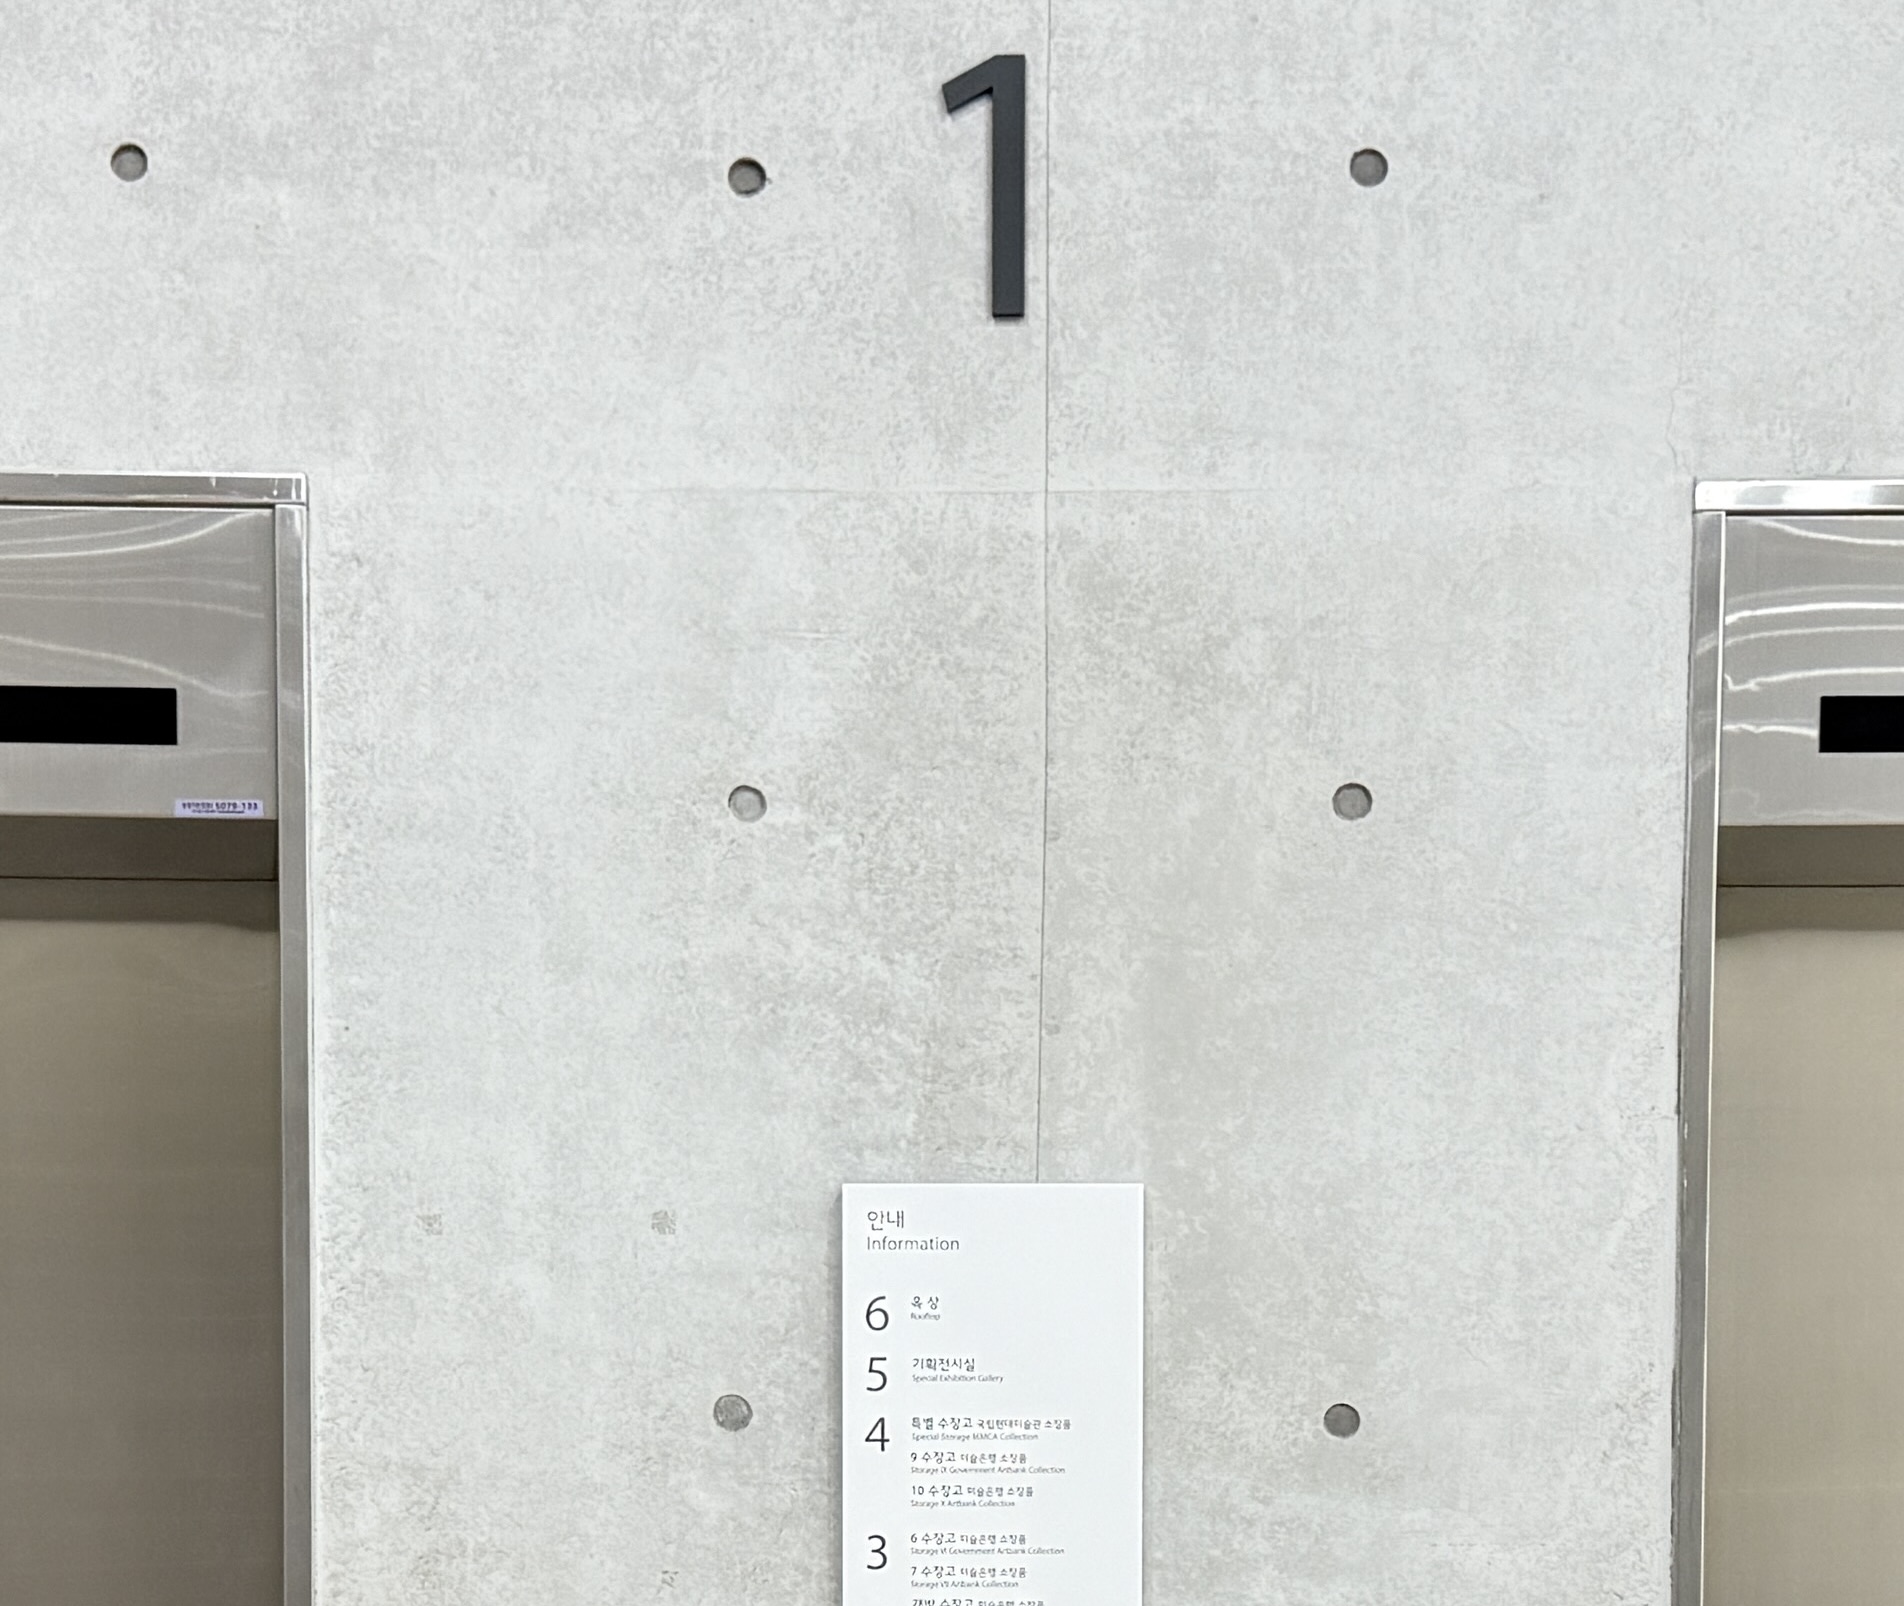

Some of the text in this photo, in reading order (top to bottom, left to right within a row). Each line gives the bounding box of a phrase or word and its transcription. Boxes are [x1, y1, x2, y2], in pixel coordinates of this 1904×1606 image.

[942, 55, 1026, 317] 1
[867, 1210, 905, 1231] 안내
[867, 1236, 960, 1251] Information
[865, 1296, 889, 1331] 6
[866, 1357, 888, 1391] 5
[913, 1358, 975, 1372] 기획전시실
[865, 1417, 890, 1452] 4
[910, 1452, 917, 1462] 9
[912, 1486, 924, 1495] 10
[911, 1534, 917, 1543] 6
[866, 1535, 888, 1569] 3
[911, 1567, 917, 1576] 7
